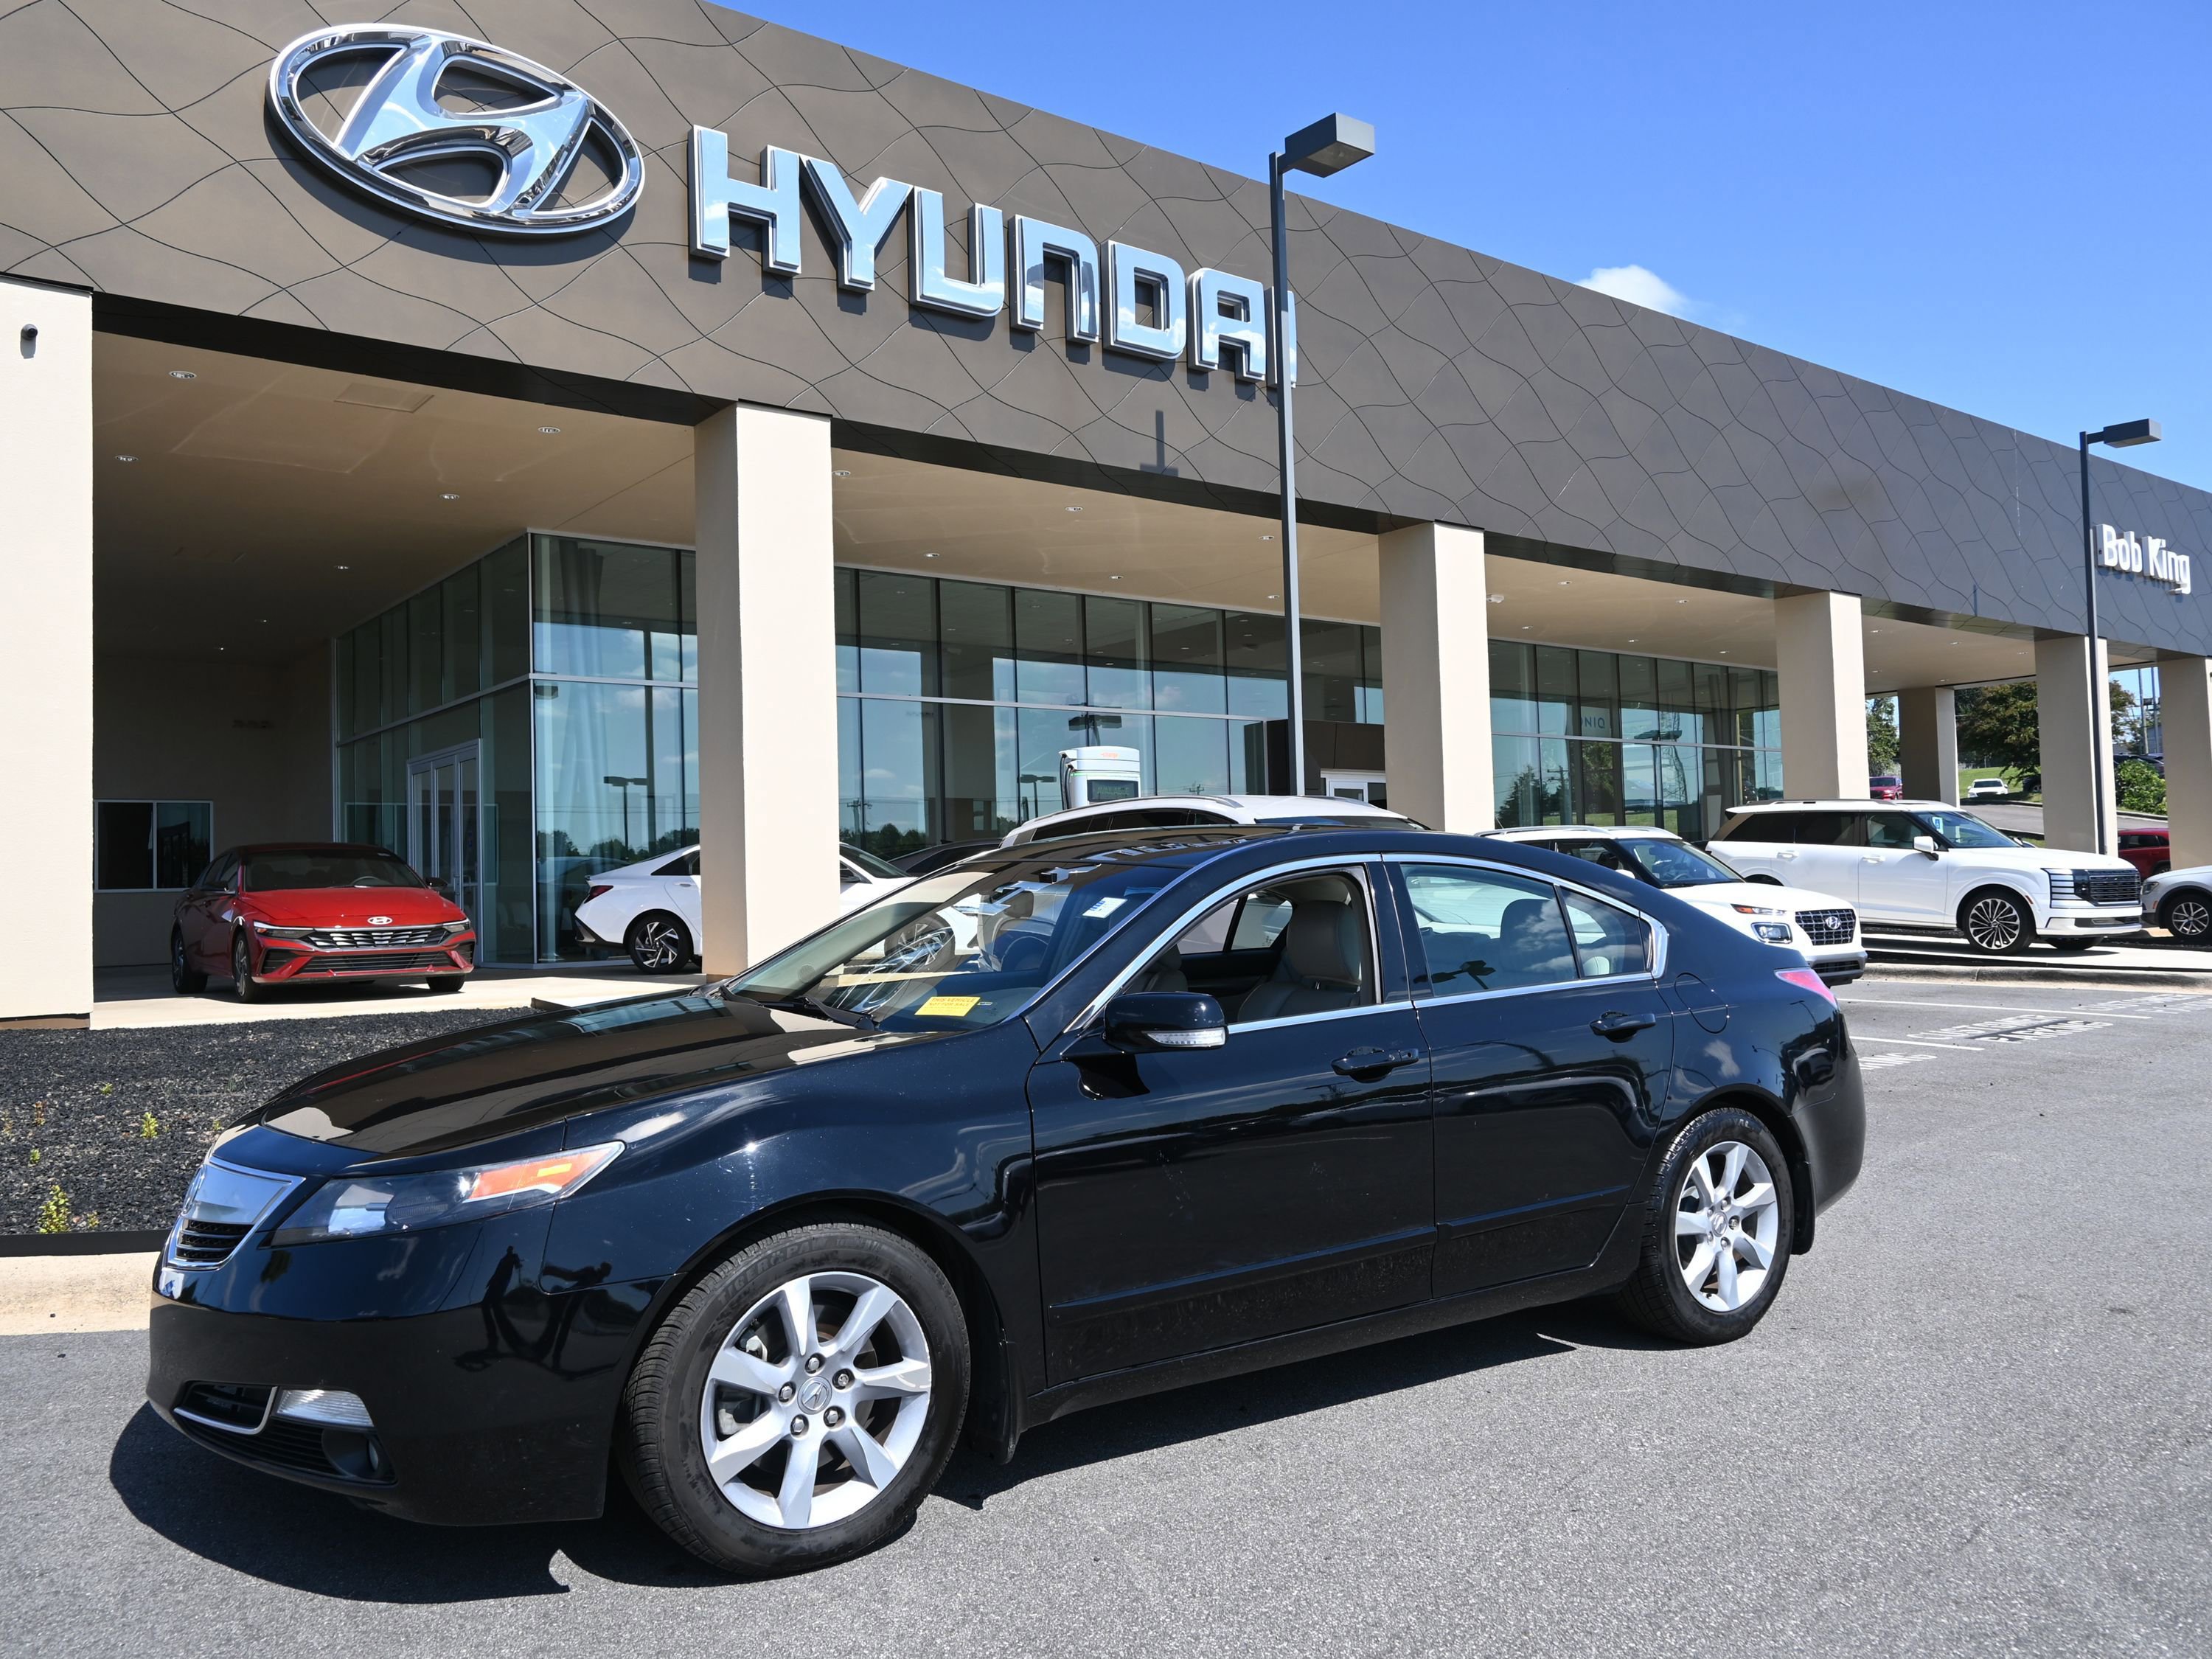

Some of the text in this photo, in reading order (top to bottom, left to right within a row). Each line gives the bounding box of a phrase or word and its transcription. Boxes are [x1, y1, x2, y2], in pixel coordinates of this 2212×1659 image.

[2097, 524, 2191, 594] Bob King
[1581, 716, 1605, 729] NIQ
[1907, 1015, 2067, 1040] CUSTOMER
[1975, 1020, 2114, 1044] PARKING
[717, 1259, 773, 1306] TIGER
[785, 1238, 828, 1259] PAW
